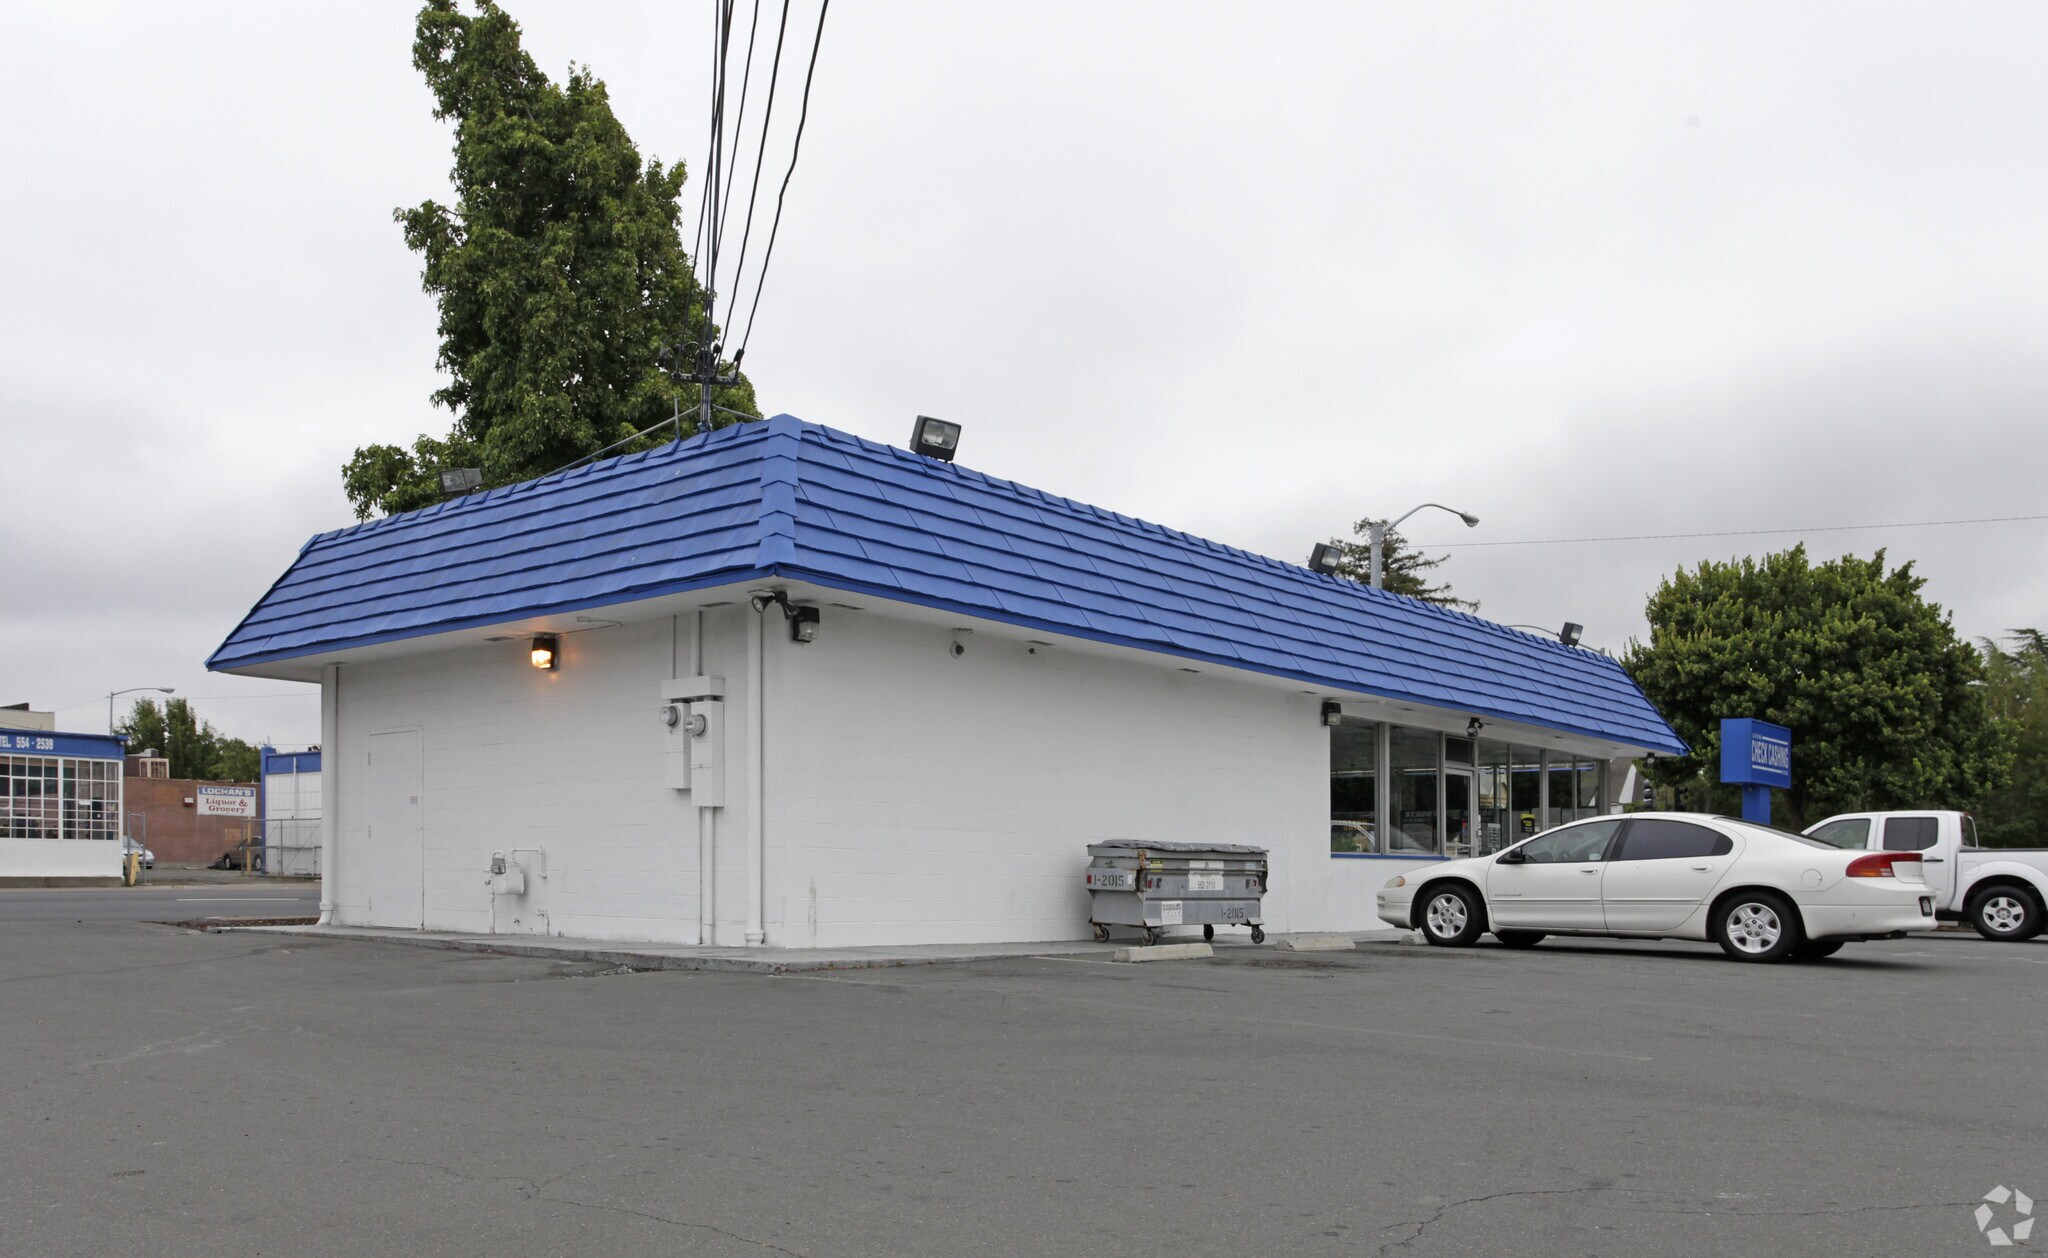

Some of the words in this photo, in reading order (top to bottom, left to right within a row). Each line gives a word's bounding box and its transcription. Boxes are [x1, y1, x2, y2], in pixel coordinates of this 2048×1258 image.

[1752, 739, 1768, 764] CHECK
[1769, 743, 1788, 768] CASHING
[206, 798, 237, 806] Liquor
[239, 799, 248, 807] &
[208, 805, 246, 814] Grocery
